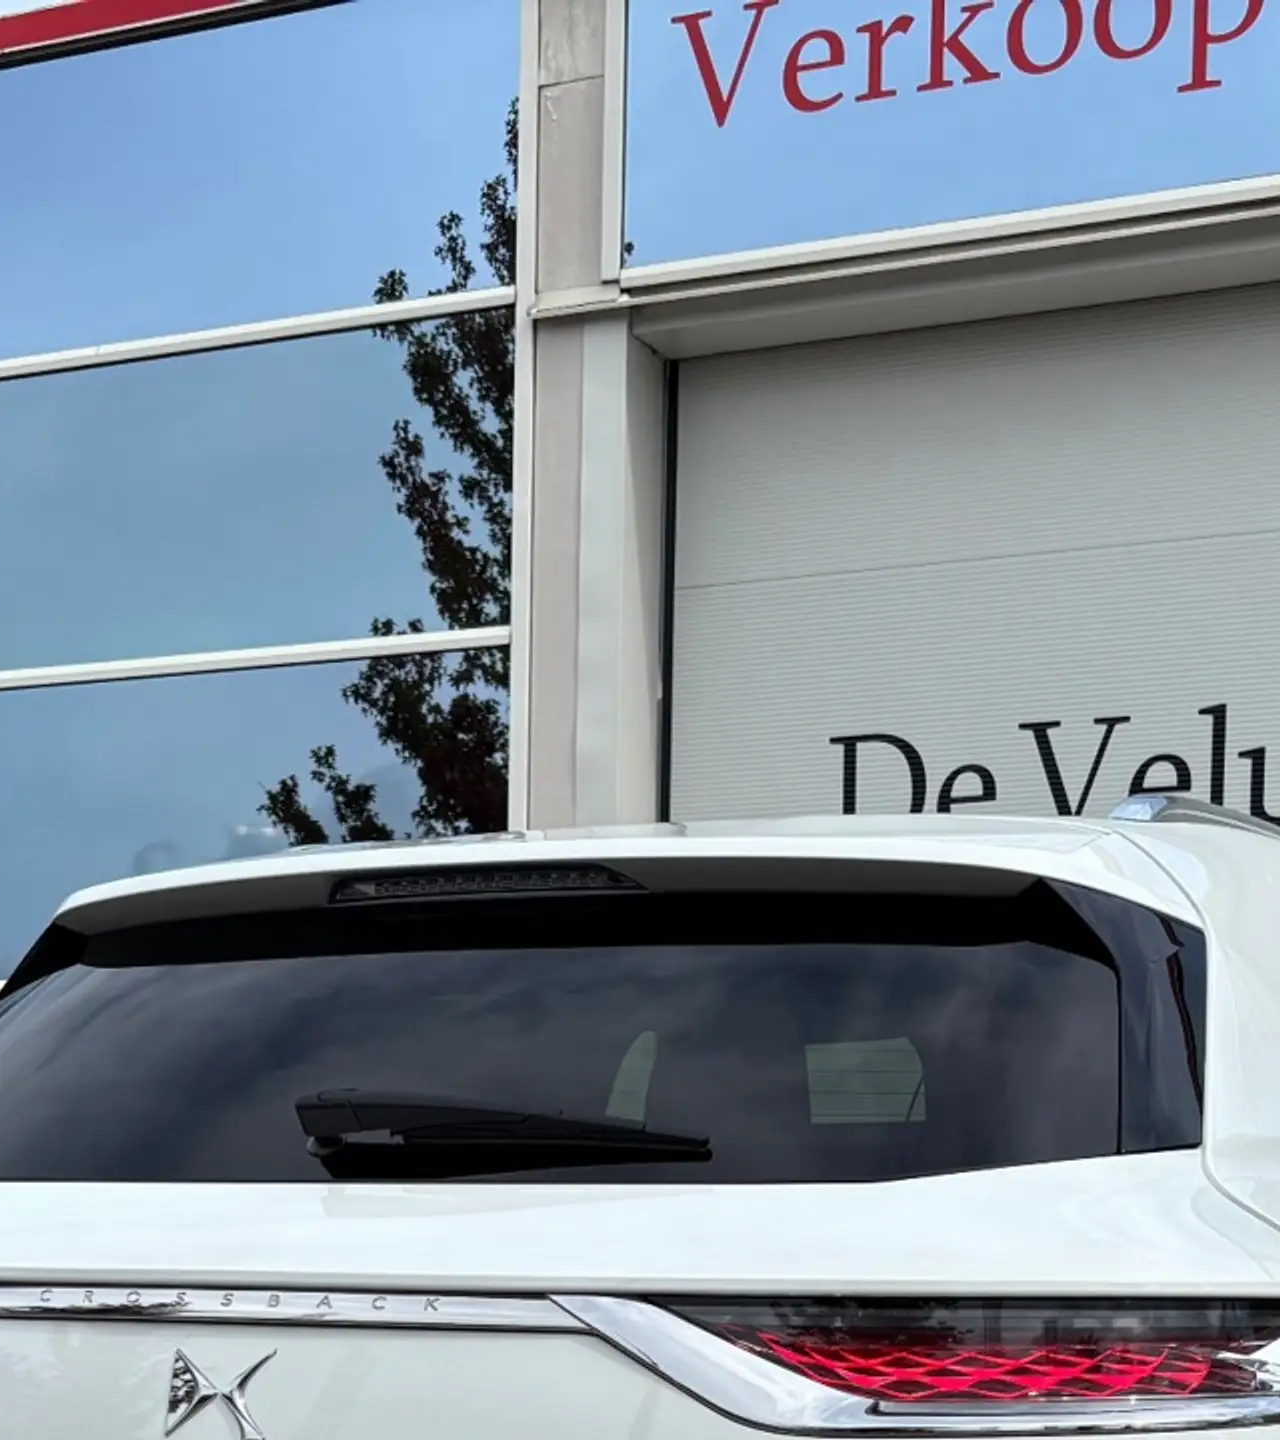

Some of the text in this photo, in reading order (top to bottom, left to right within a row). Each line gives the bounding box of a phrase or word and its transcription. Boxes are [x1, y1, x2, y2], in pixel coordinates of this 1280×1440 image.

[671, 0, 1265, 129] Verkoop
[828, 733, 997, 815] De
[39, 1289, 441, 1313] CROSSBACK
